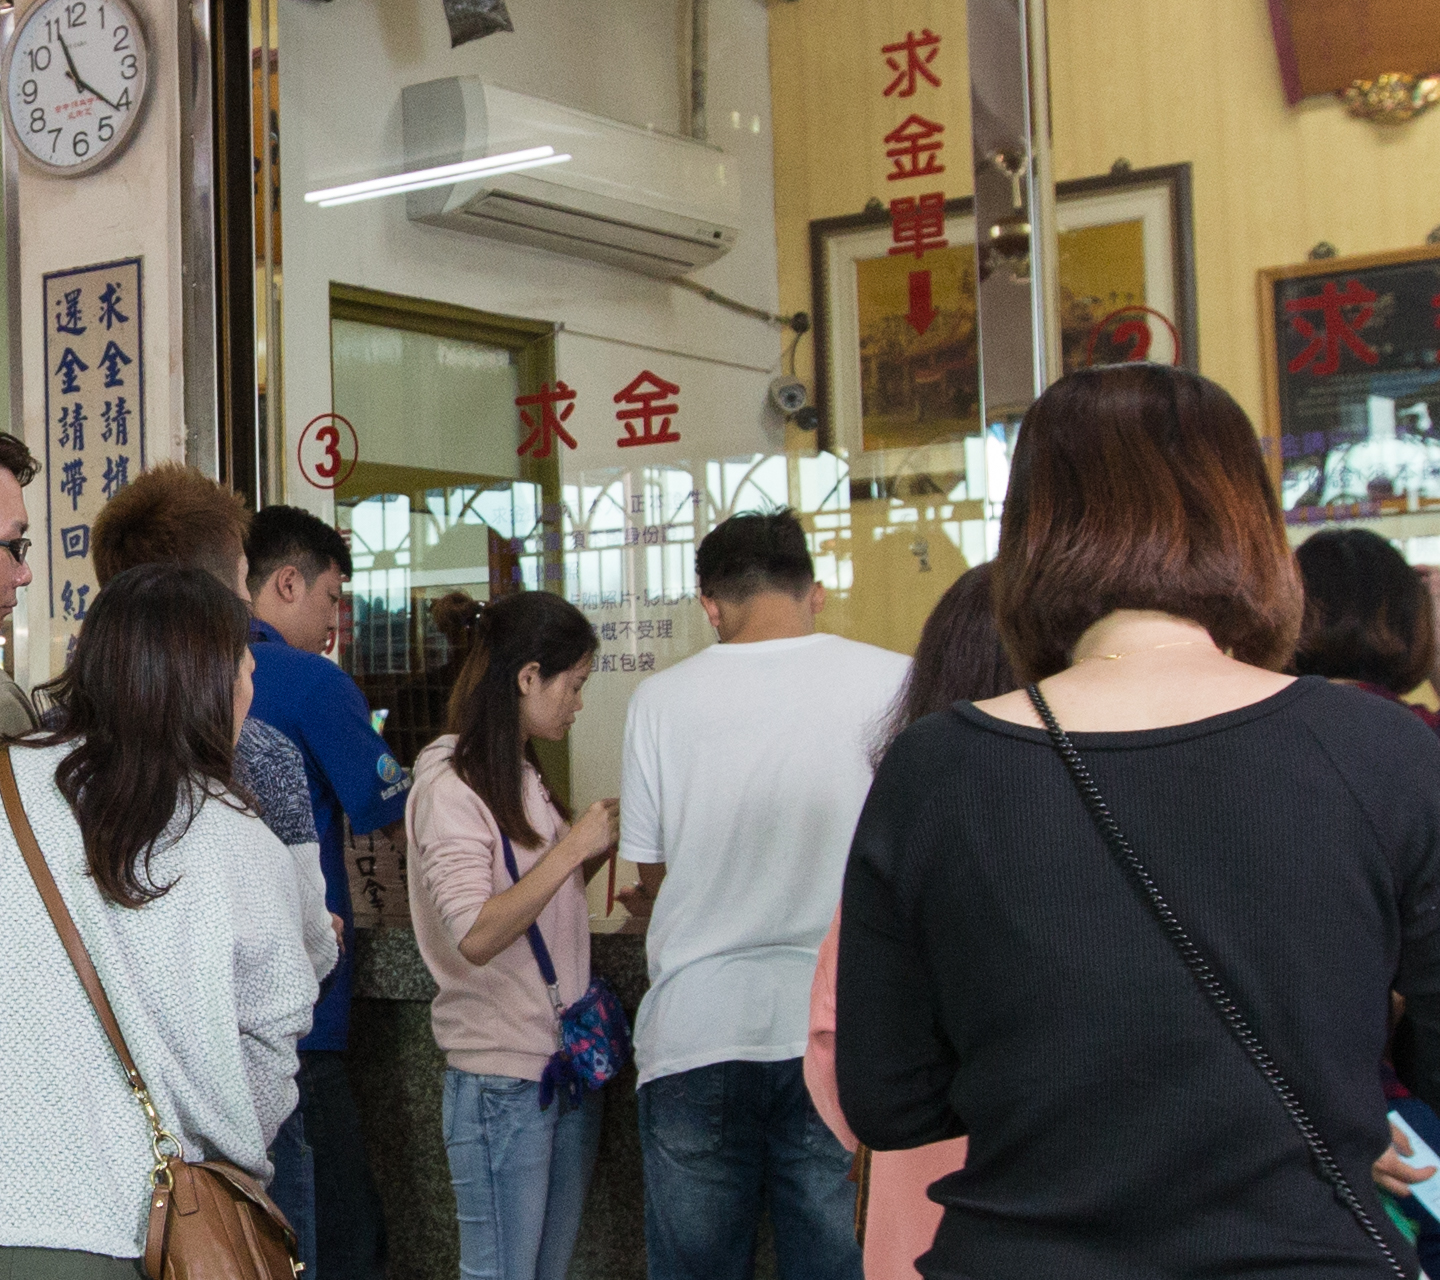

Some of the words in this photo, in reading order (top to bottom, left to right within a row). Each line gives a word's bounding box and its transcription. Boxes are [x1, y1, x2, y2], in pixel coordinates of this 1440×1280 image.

[65, 2, 87, 28] 12
[98, 5, 105, 29] 1
[45, 17, 61, 43] 11
[113, 25, 129, 52] 2
[28, 46, 51, 72] 10
[121, 54, 138, 80] 3
[22, 79, 38, 104] 9
[116, 87, 132, 111] 4
[30, 108, 46, 133] 8
[98, 115, 114, 142] 5
[48, 127, 63, 153] 7
[73, 131, 89, 157] 6
[881, 28, 949, 260] 求金單
[515, 369, 682, 459] 求金
[55, 288, 90, 668] 還金請帶回紅
